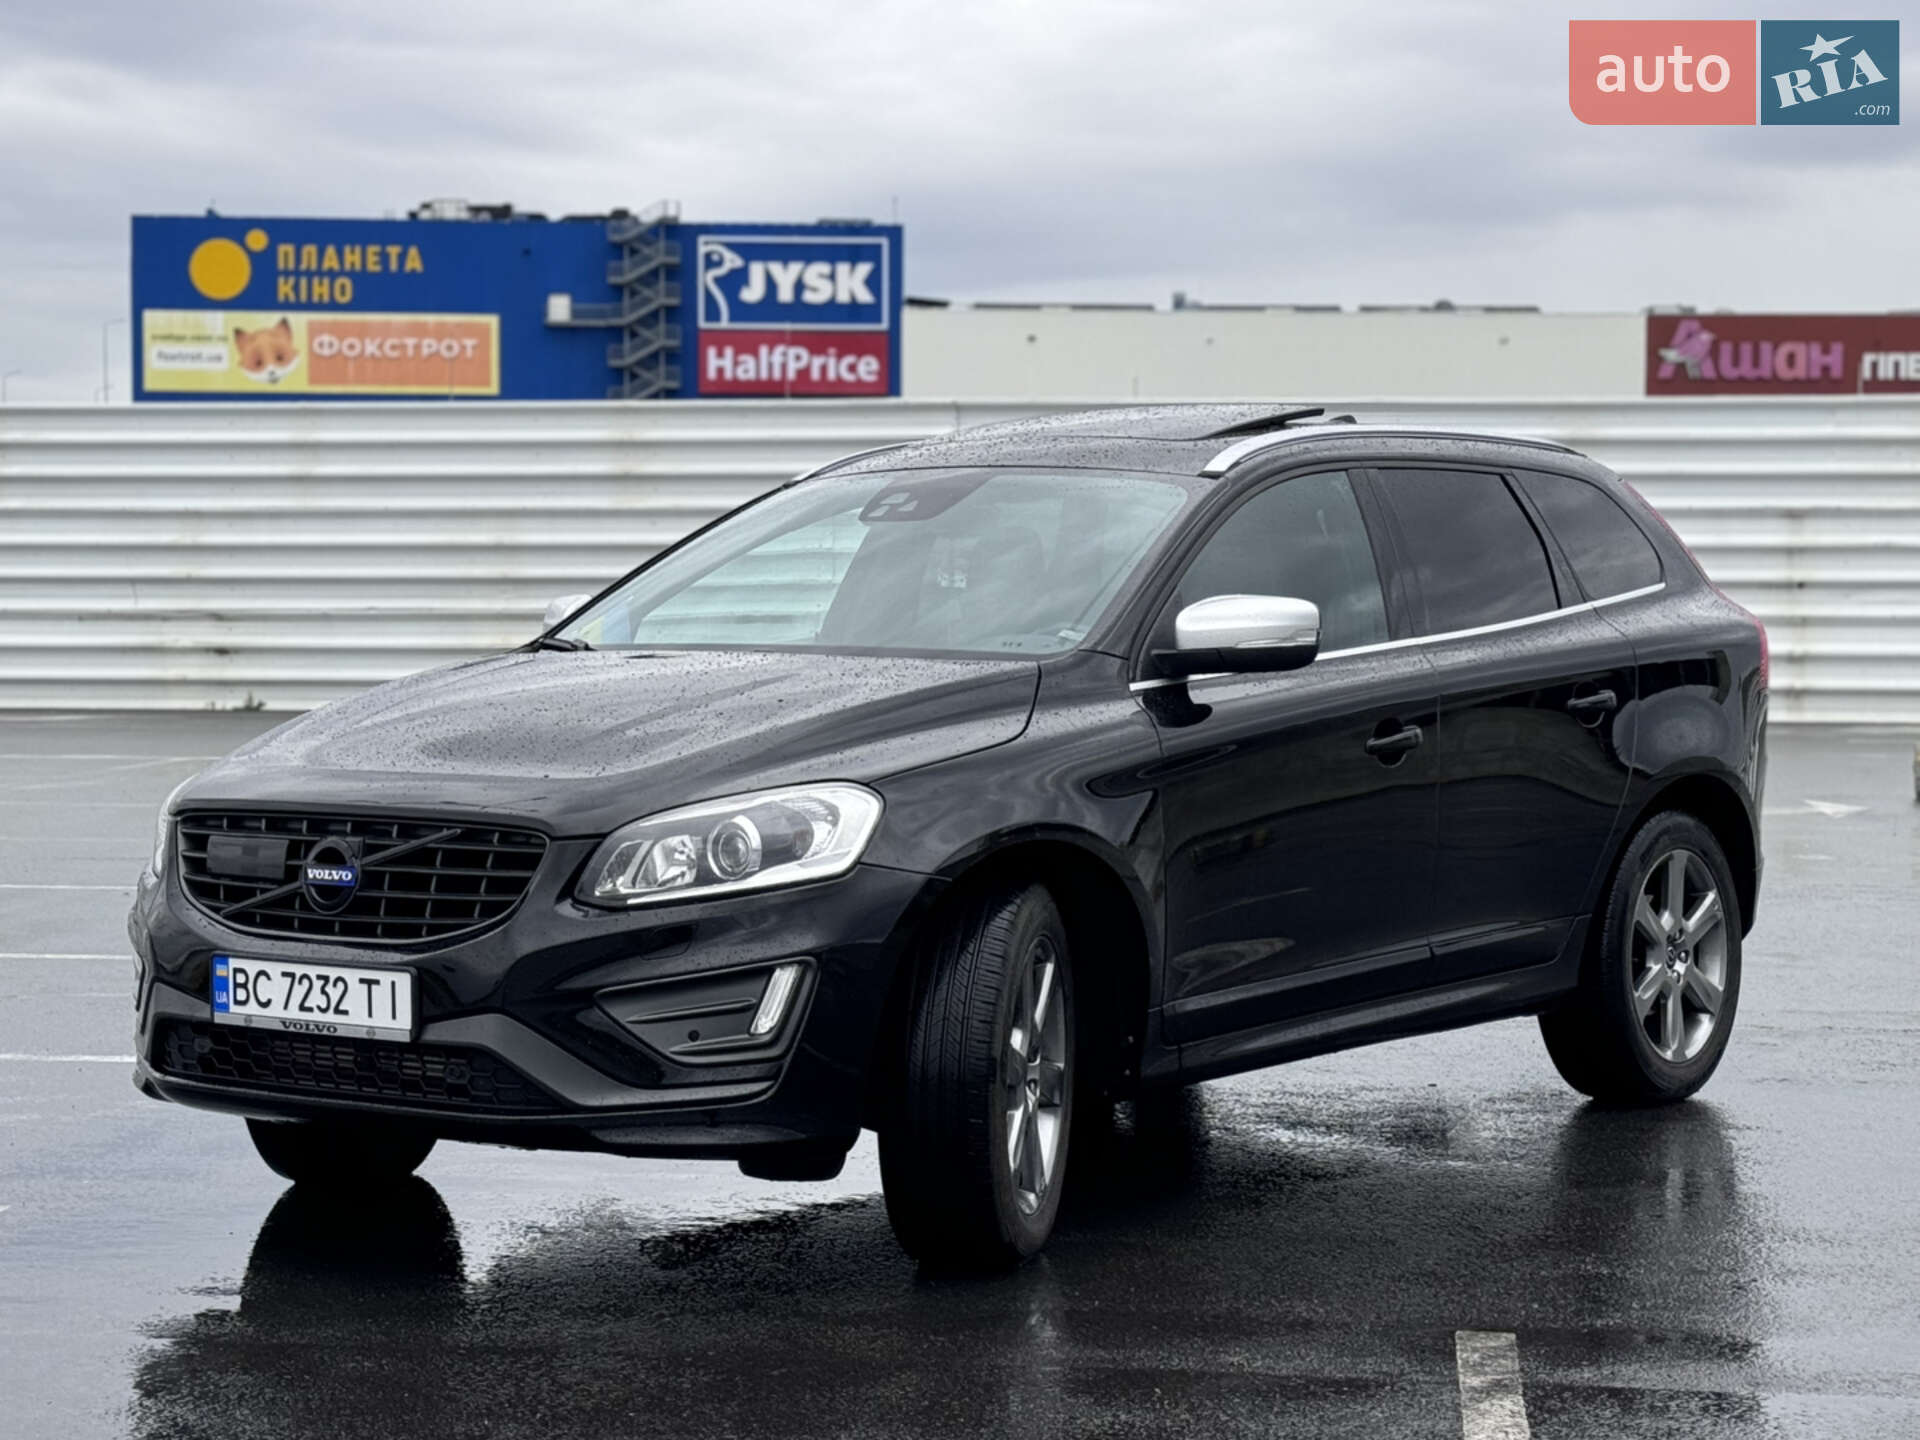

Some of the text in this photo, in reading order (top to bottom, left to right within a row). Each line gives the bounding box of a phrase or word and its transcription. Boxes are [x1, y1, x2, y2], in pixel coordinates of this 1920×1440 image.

[277, 244, 423, 272] ПЛАНЕТА
[277, 276, 353, 303] КІНО
[738, 261, 876, 304] JYSK
[312, 333, 478, 358] ФОКСТРОТ
[706, 344, 880, 382] HalfPrice
[307, 868, 353, 881] VOLVO
[216, 991, 228, 1004] UA
[232, 967, 397, 1021] BC 7232 TI
[280, 1020, 338, 1035] VOLVO
